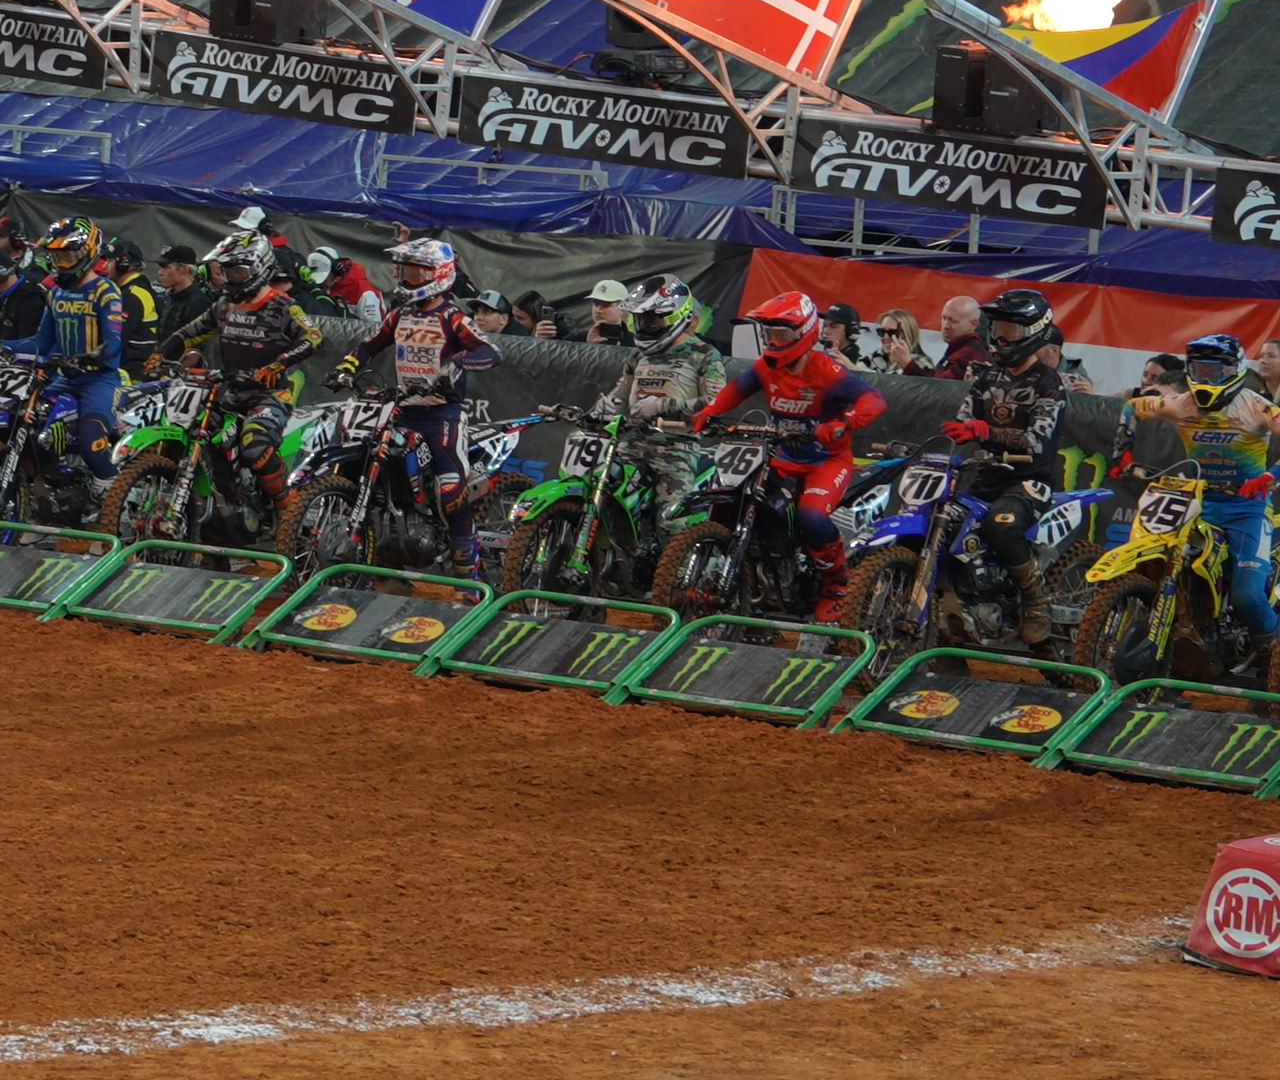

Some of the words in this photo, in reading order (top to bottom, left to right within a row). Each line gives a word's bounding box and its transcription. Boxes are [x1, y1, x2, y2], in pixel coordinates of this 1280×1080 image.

[200, 42, 268, 75] ROCKY
[270, 54, 399, 92] MOUNTAIN
[517, 87, 597, 118] ROCKY
[598, 98, 731, 134] MOUNTAIN
[850, 130, 934, 164] ROCKY
[935, 141, 1087, 182] MOUNTAIN
[398, 328, 444, 345] FXR
[397, 366, 436, 374] HONDA
[406, 355, 437, 364] LOCK
[168, 389, 195, 414] 41
[347, 403, 381, 431] 12
[564, 440, 603, 468] 719
[718, 446, 760, 476] 46
[904, 473, 945, 502] 711
[1141, 496, 1188, 527] 45
[1148, 594, 1165, 642] DUNLOP
[1220, 890, 1274, 936] RM
